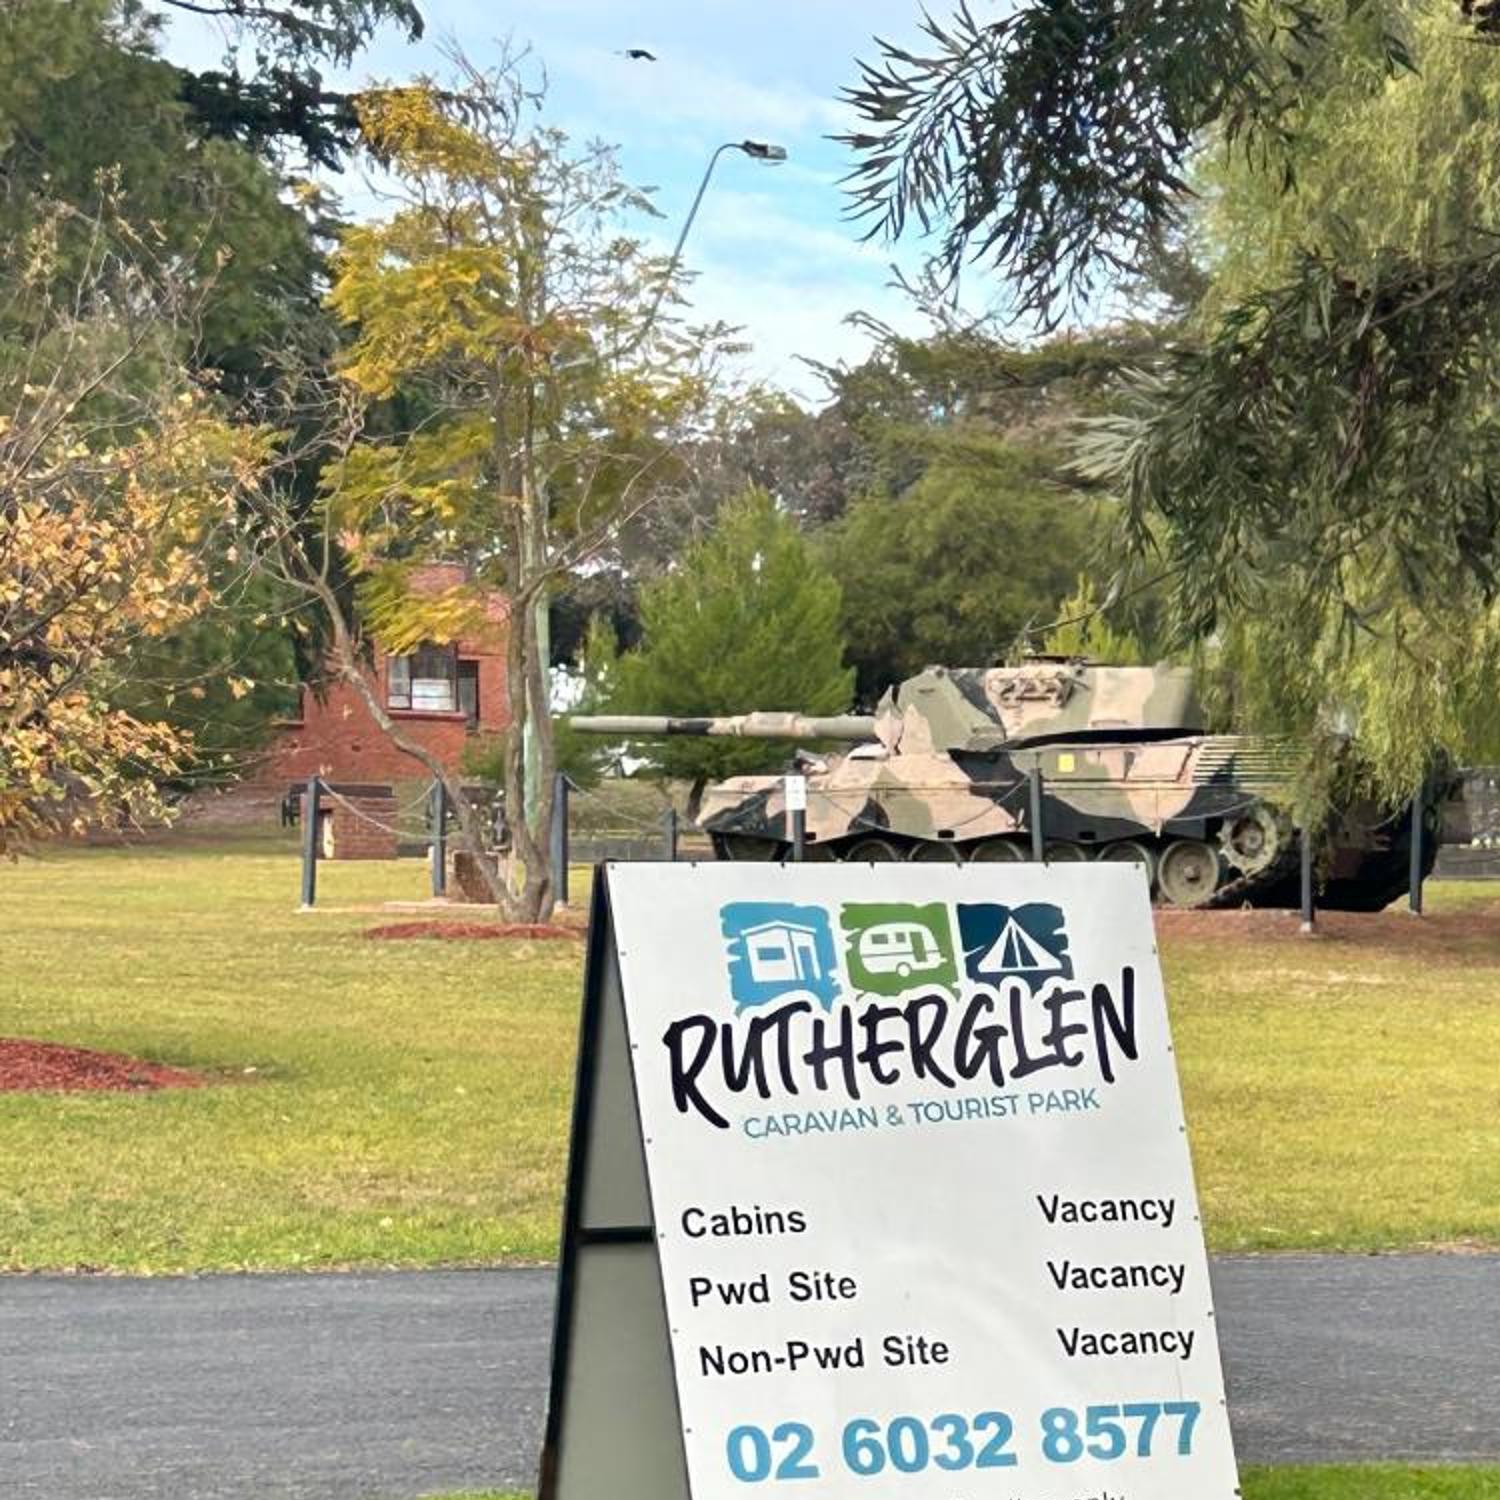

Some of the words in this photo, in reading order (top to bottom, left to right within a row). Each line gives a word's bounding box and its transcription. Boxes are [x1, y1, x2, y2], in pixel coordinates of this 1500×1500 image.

[663, 966, 1137, 1128] RUTHERGLEN
[744, 1107, 878, 1138] CARAVAN
[887, 1105, 904, 1126] &
[911, 1095, 1018, 1123] TOURIST
[1028, 1088, 1100, 1113] PARK
[682, 1205, 806, 1238] Cabins
[1036, 1194, 1175, 1228] Vacancy
[690, 1274, 770, 1307] Pwd
[789, 1271, 856, 1302] Site
[1046, 1260, 1185, 1293] Vacancy
[700, 1338, 864, 1376] Non-Pwd
[883, 1336, 949, 1366] Site
[1057, 1328, 1194, 1360] Vacancy
[727, 1422, 819, 1482] 02
[842, 1412, 1017, 1476] 6032
[1040, 1402, 1200, 1463] 8577
